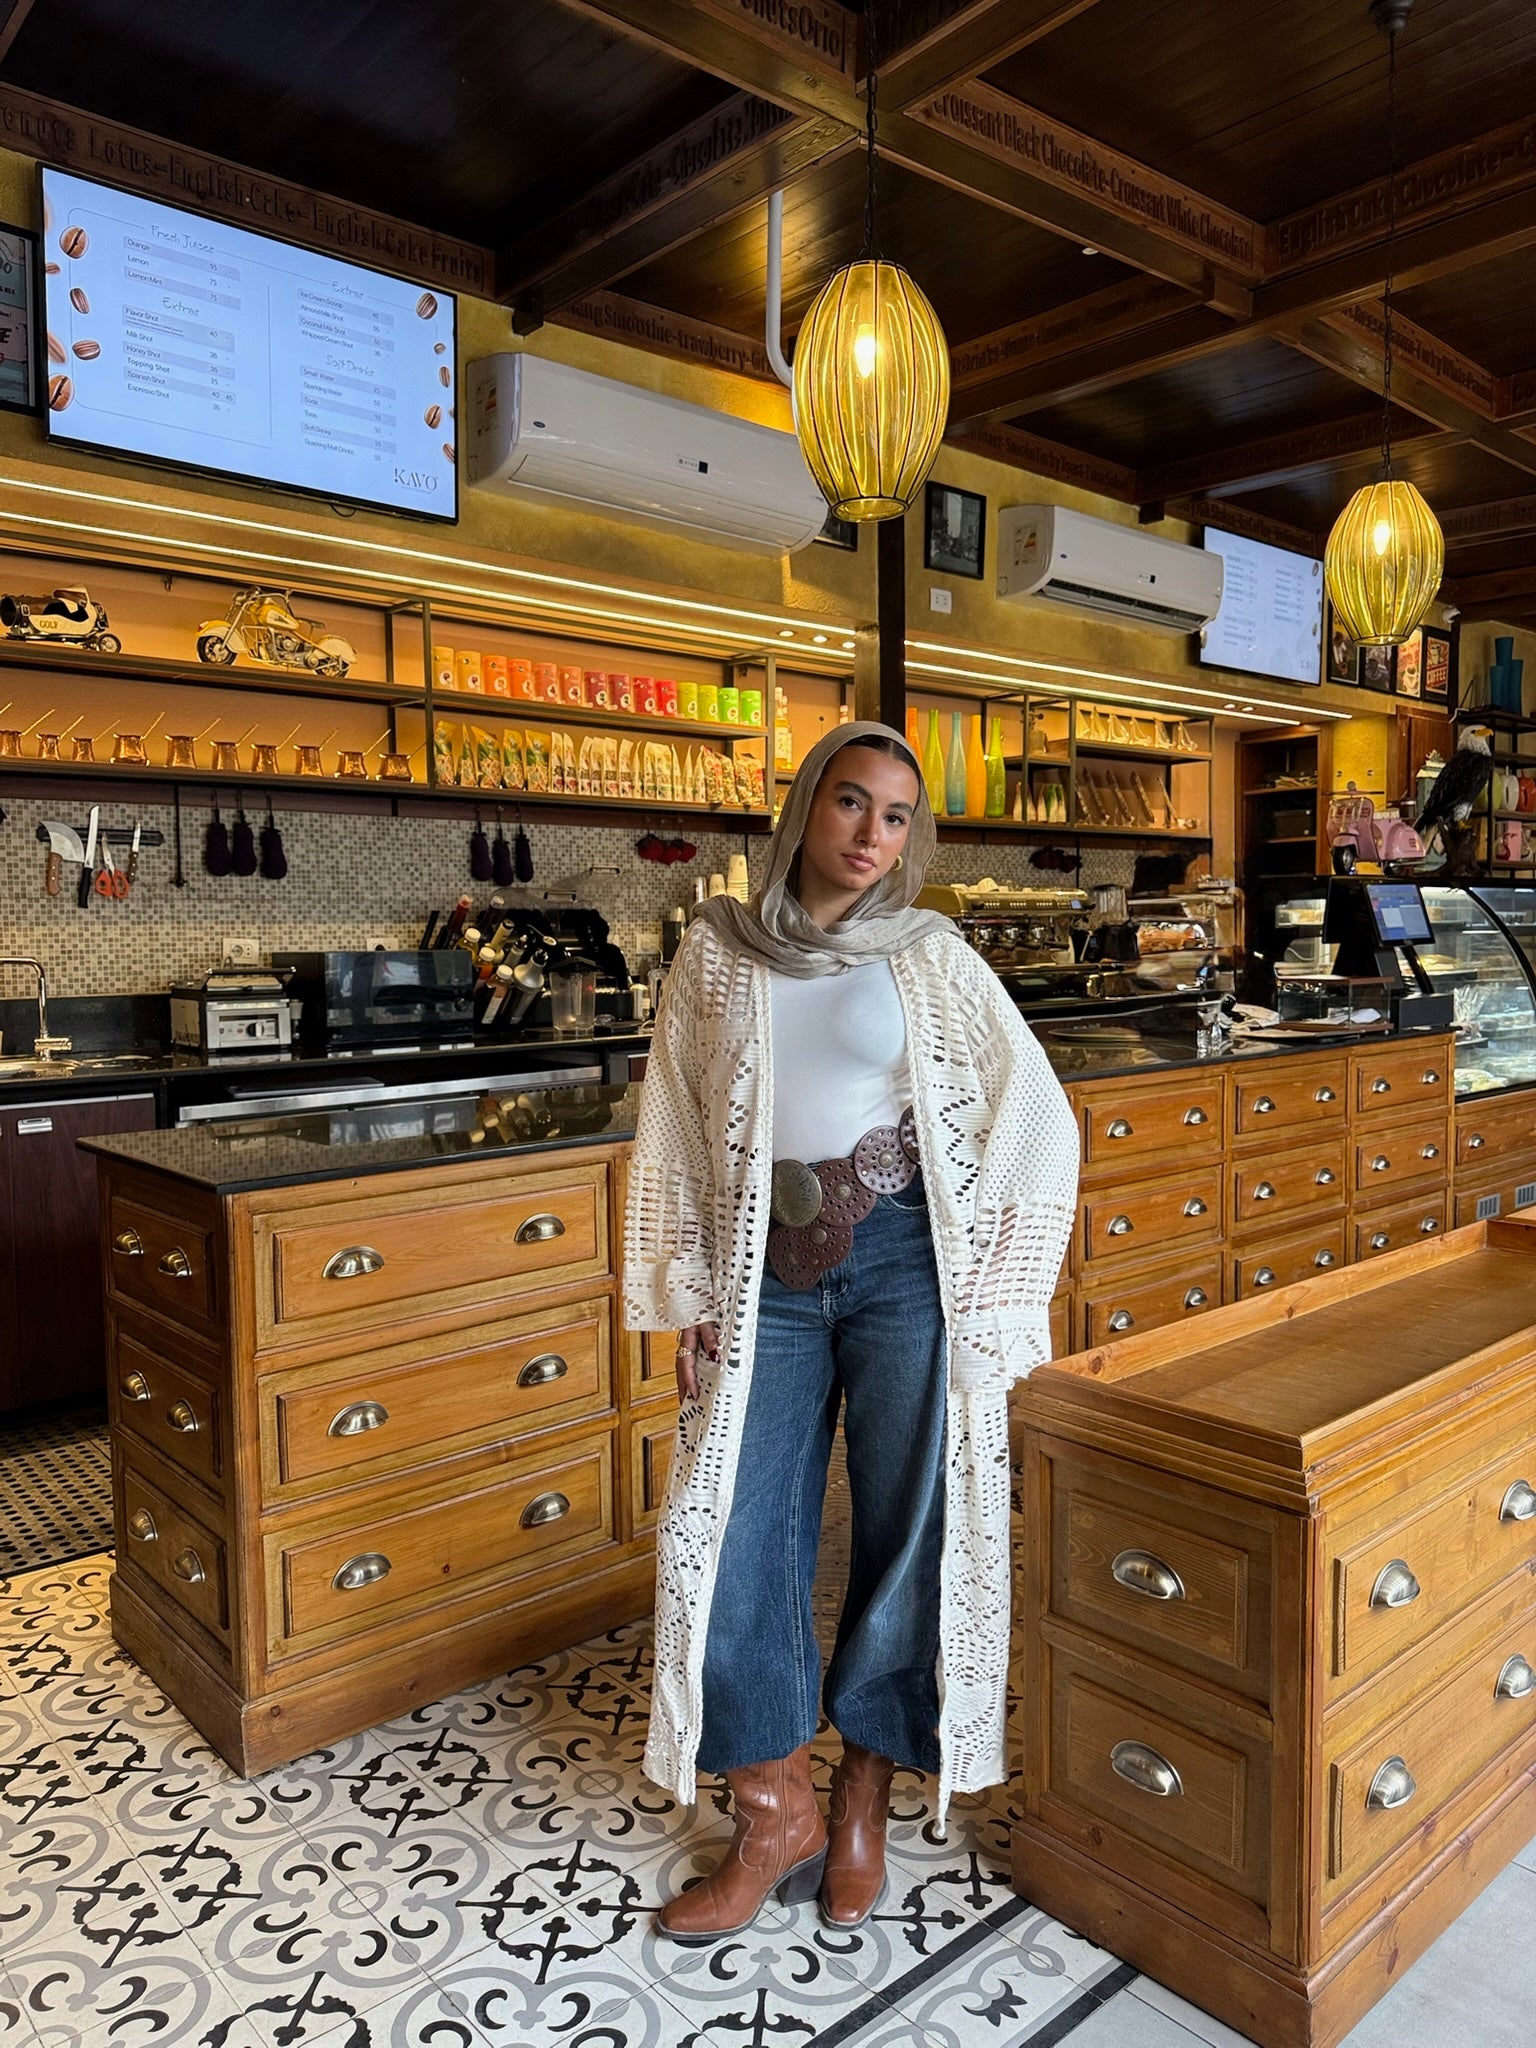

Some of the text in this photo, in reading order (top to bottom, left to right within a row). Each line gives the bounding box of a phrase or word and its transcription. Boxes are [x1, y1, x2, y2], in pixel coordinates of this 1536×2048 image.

[127, 254, 150, 266] Lemon
[127, 270, 150, 281] Lemon
[127, 357, 154, 371] Topping
[1427, 665, 1447, 685] COFFEE
